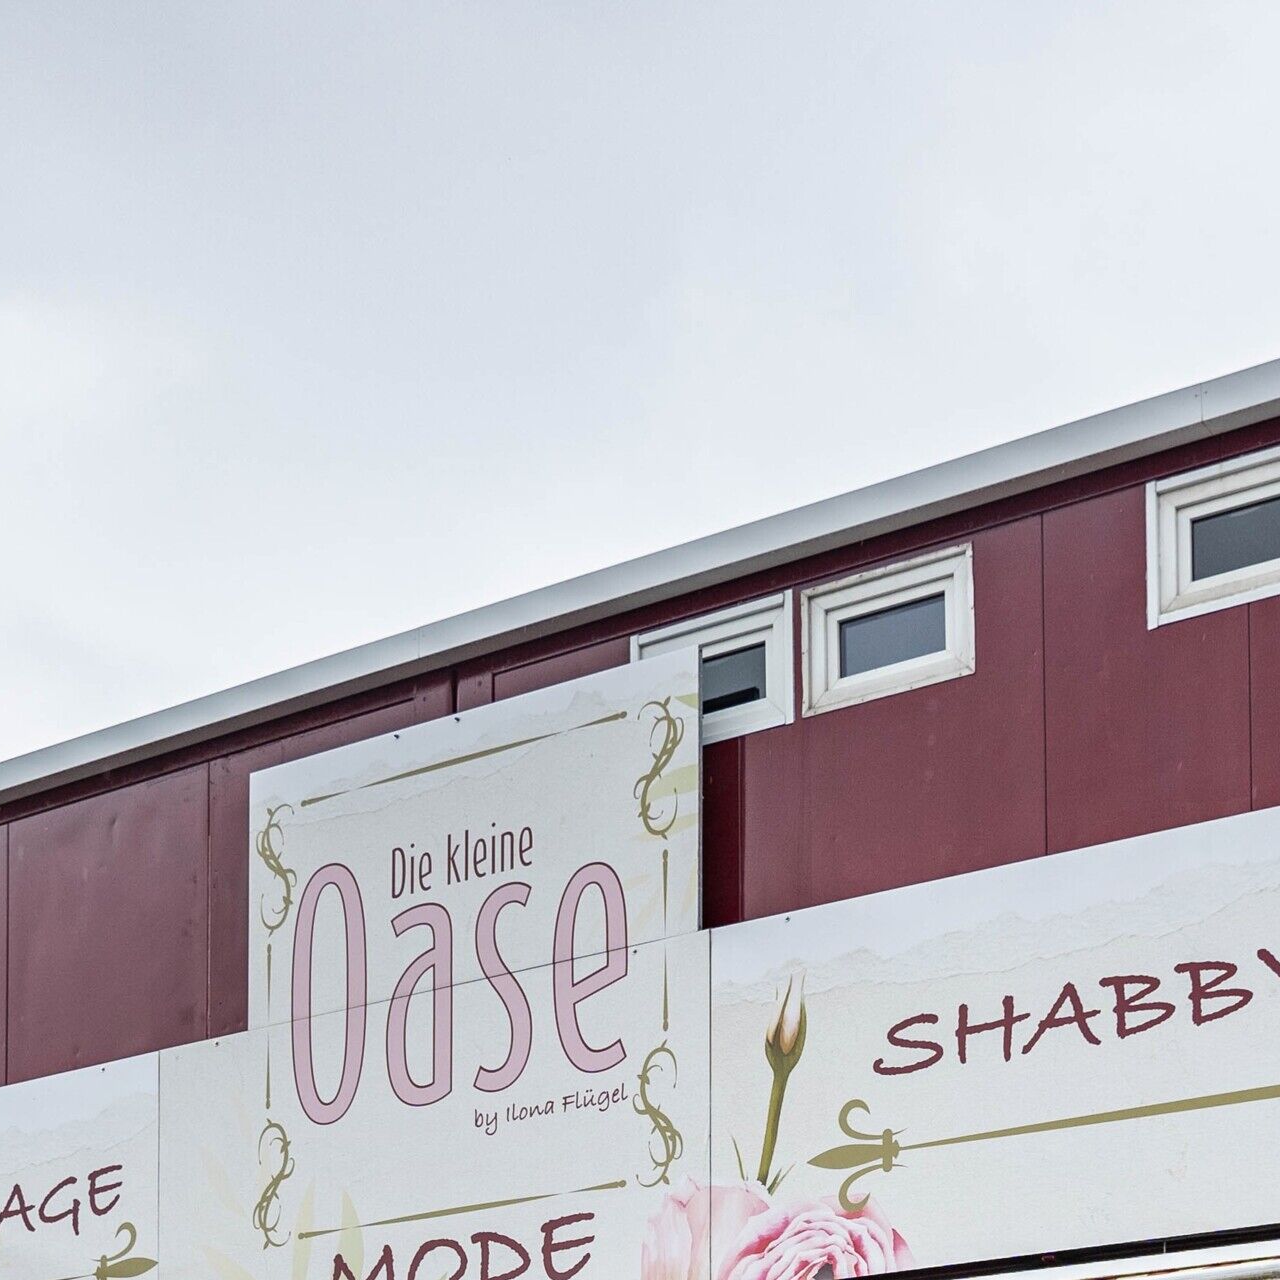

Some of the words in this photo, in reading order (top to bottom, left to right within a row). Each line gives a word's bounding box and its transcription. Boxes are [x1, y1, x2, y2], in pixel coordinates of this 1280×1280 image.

[391, 843, 433, 899] Die
[447, 822, 533, 886] kleine
[291, 862, 629, 1125] Oase
[474, 1108, 498, 1136] by
[506, 1100, 555, 1122] Ilona
[562, 1082, 629, 1112] Flügel
